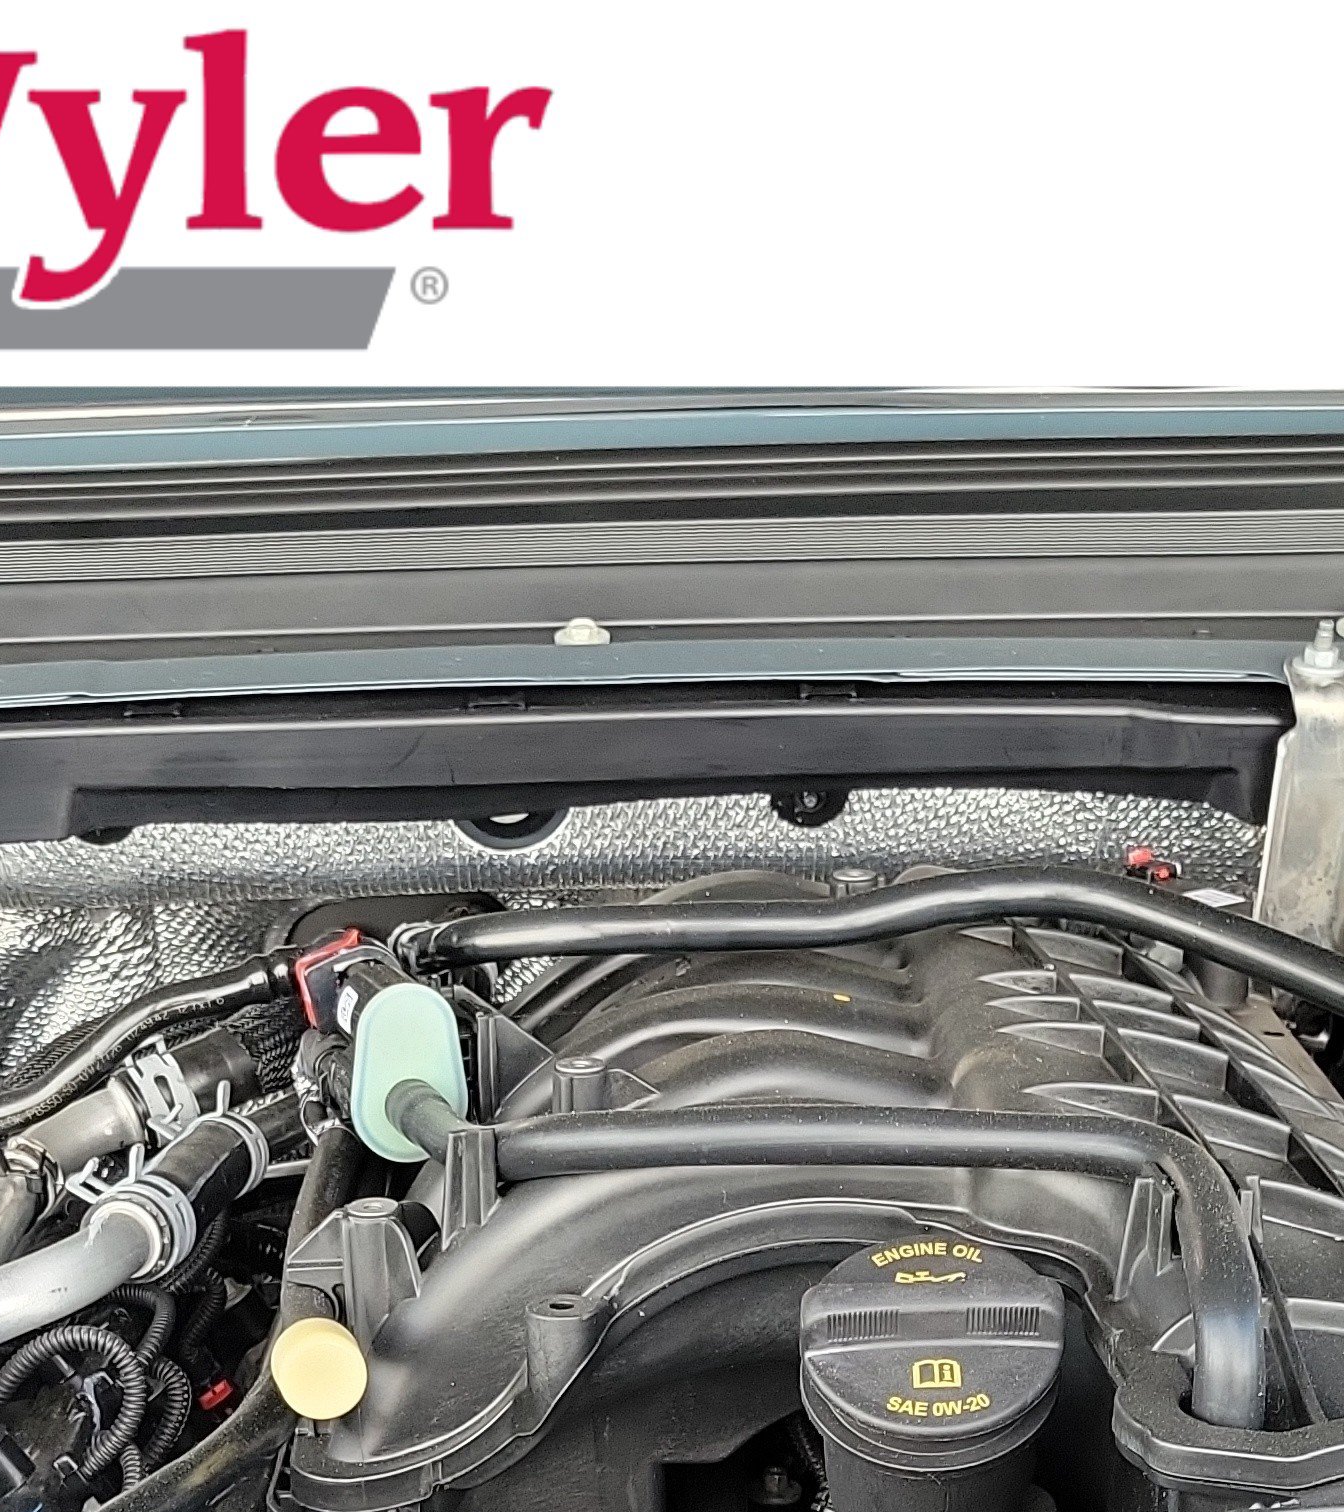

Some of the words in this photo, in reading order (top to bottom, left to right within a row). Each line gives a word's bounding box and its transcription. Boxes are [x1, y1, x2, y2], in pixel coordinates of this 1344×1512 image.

[870, 1242, 948, 1268] ENGINE
[952, 1243, 984, 1263] OIL
[886, 1395, 929, 1416] SAE
[931, 1393, 991, 1418] 0W-20
